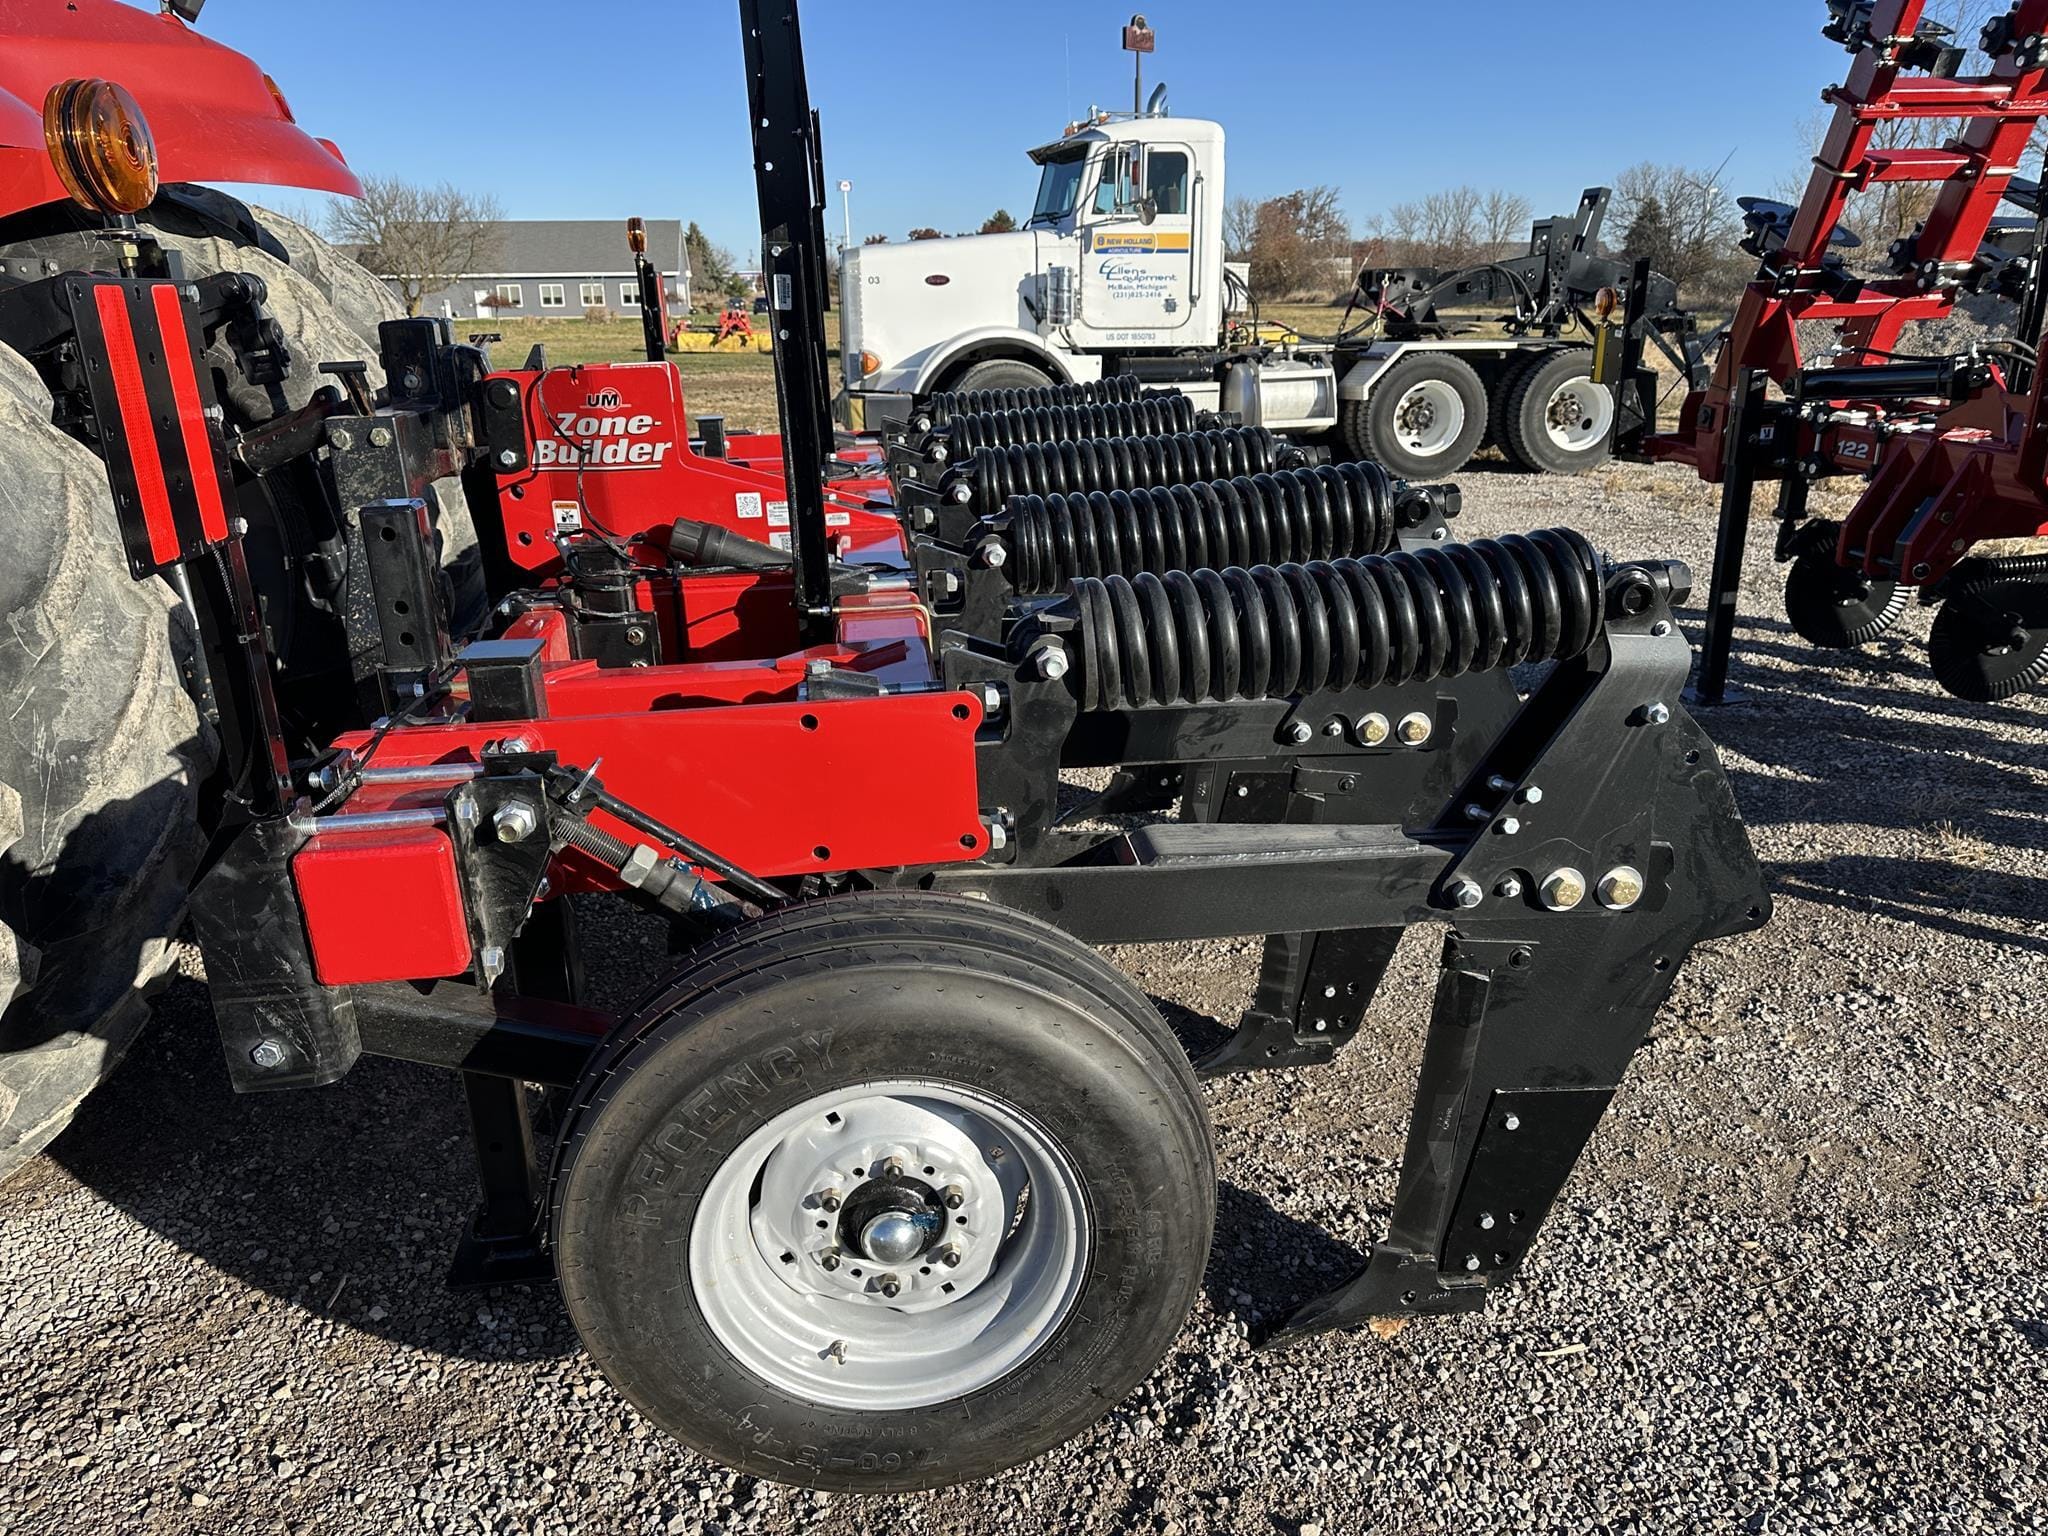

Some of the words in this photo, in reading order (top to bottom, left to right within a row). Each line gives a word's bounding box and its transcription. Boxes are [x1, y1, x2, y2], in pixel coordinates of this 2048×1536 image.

[1099, 257, 1146, 274] Ellens
[868, 276, 880, 285] 03
[1106, 266, 1177, 282] Equipment
[1108, 283, 1135, 291] McBain,
[1136, 283, 1168, 292] Michigan
[1106, 333, 1114, 341] US
[1116, 333, 1129, 341] DOT
[587, 394, 619, 408] UM
[554, 412, 662, 437] Zone-
[531, 438, 673, 465] Builder
[1838, 439, 1869, 459] 122
